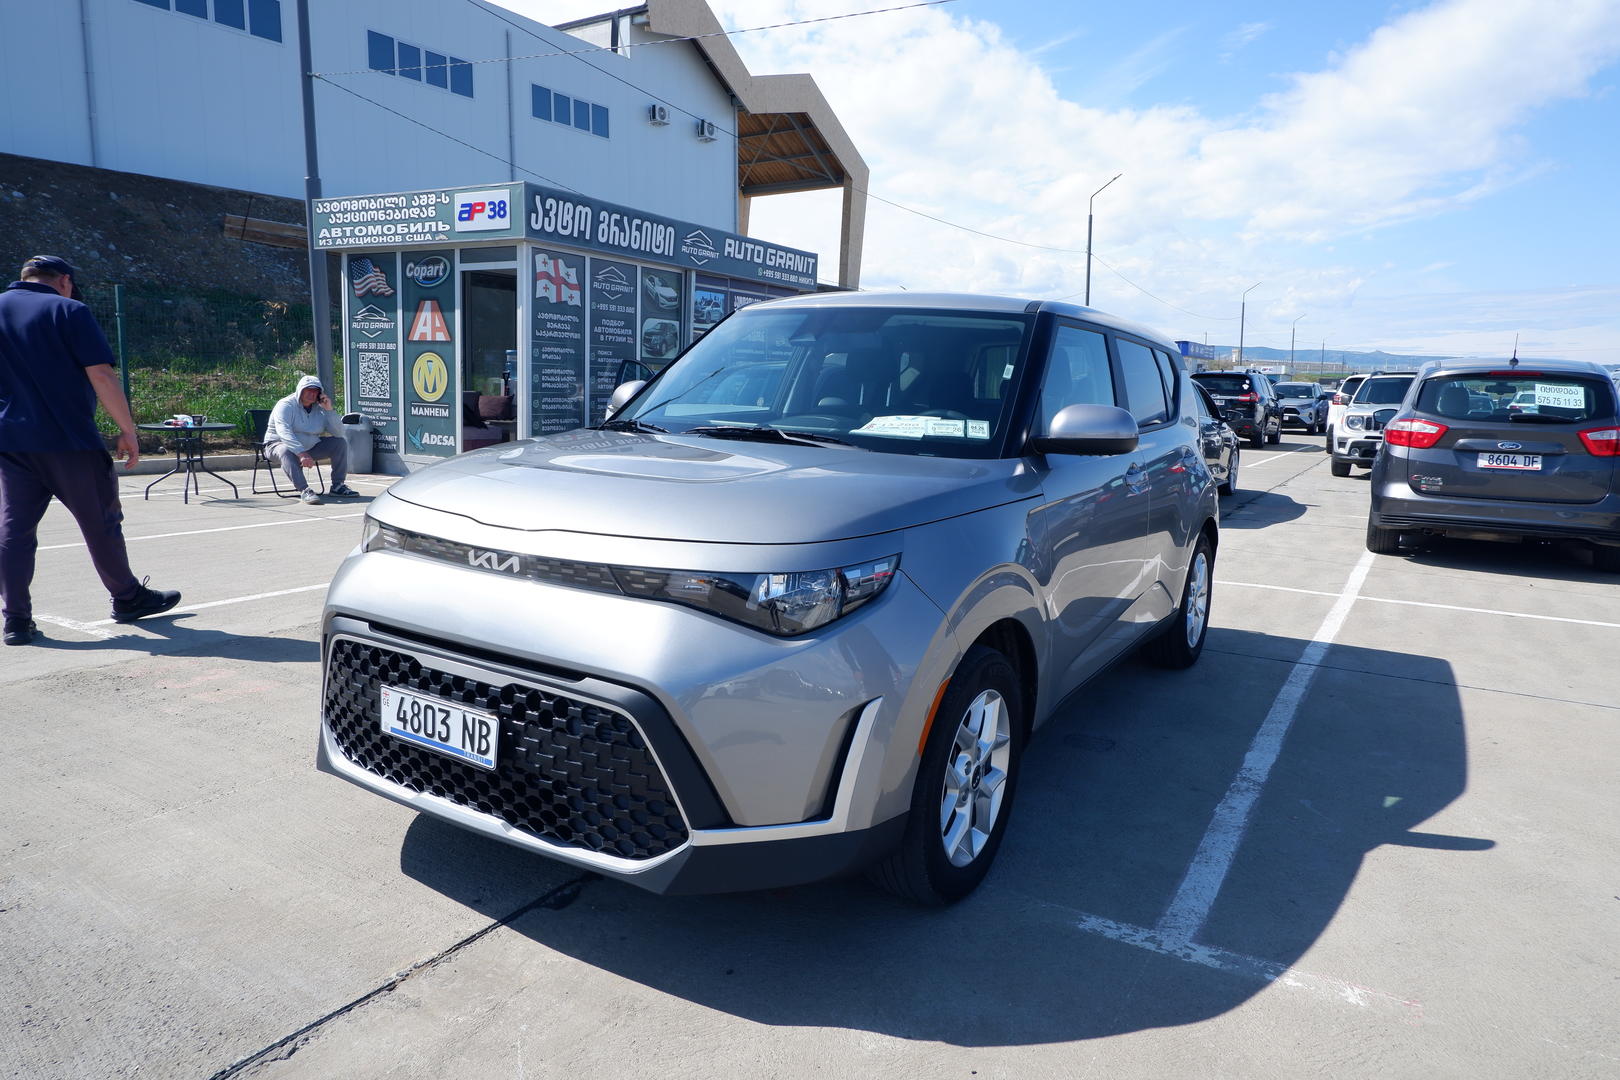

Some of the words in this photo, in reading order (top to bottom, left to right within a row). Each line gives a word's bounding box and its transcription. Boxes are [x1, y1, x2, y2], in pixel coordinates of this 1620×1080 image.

[316, 196, 407, 215] ავტომობილი
[411, 192, 450, 207] აშშ-ს
[487, 200, 507, 220] 38
[328, 206, 436, 224] აუქციონებიდან
[318, 221, 451, 238] АВТОМОБИЛЬ
[530, 194, 593, 240] ავტო
[597, 210, 675, 257] გრანიტი
[319, 238, 333, 246] ИЗ
[335, 235, 402, 246] АУКЦИОНОВ
[405, 233, 433, 242] США
[681, 244, 698, 256] AUTO
[698, 247, 720, 260] GRANIT
[724, 237, 764, 264] AUTO
[765, 246, 816, 275] GRANIT
[405, 261, 445, 280] Copart
[593, 281, 610, 291] AUTO
[610, 284, 635, 295] GRANIT
[601, 318, 625, 327] ПОДБОР
[593, 326, 633, 336] АВТОМОБИЛЯ
[1537, 395, 1551, 404] 575
[1552, 397, 1562, 406] 75
[1563, 398, 1571, 406] 11
[1572, 398, 1582, 407] 33
[411, 406, 449, 417] MANHEIM
[422, 432, 456, 446] ADESA
[1487, 454, 1518, 466] 8604
[1523, 455, 1539, 467] DF
[396, 696, 451, 743] 4803
[461, 713, 492, 756] NB
